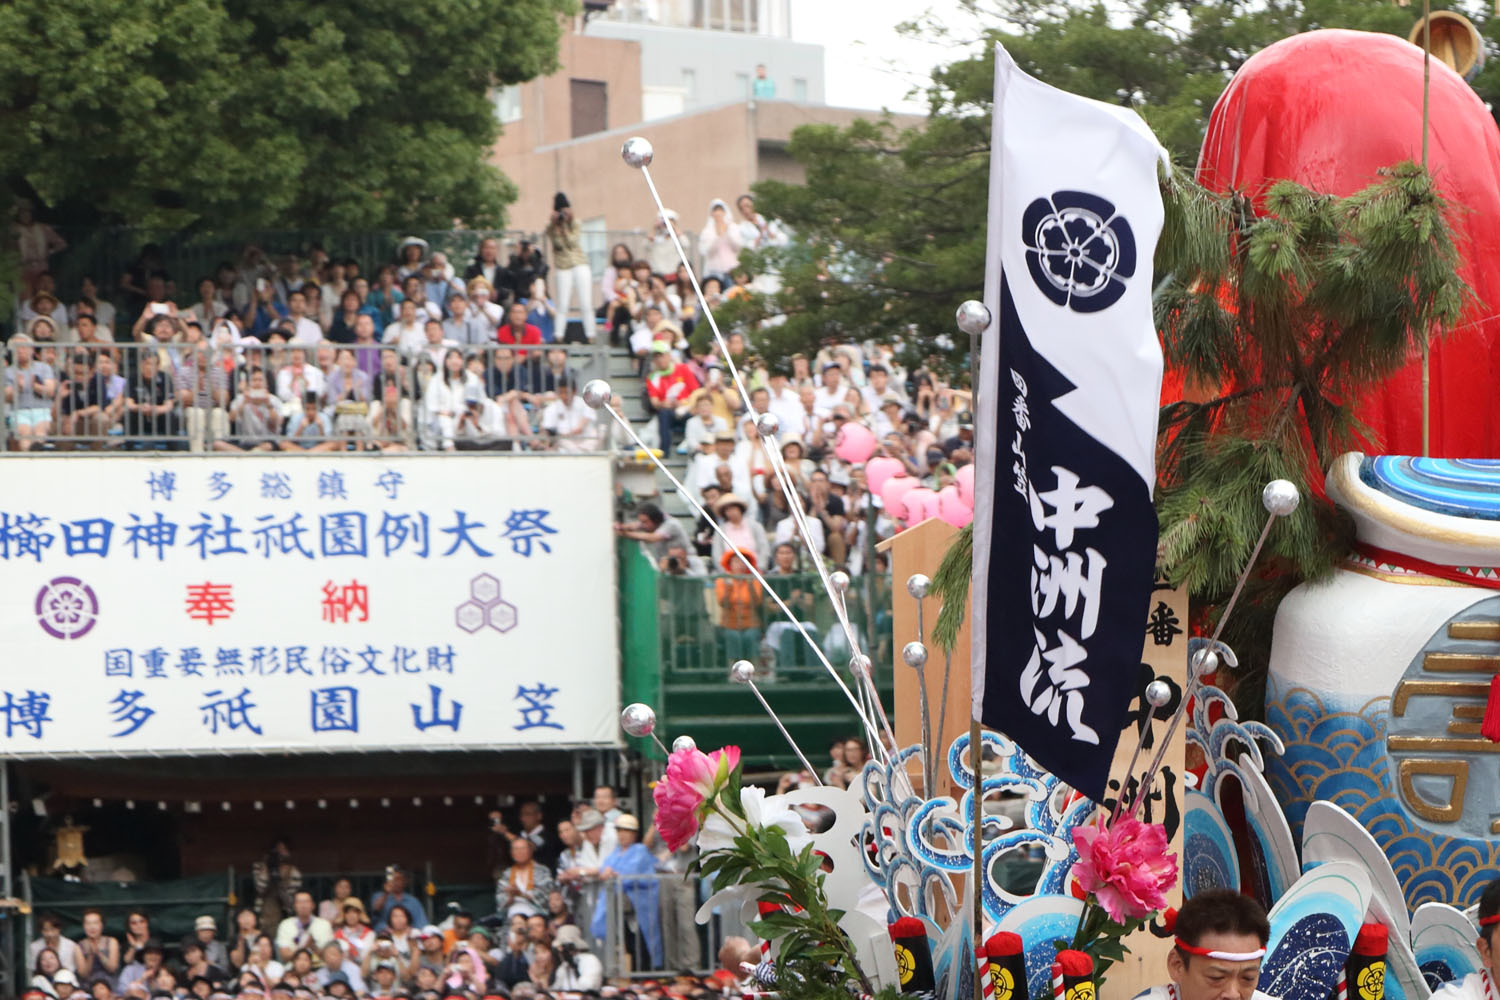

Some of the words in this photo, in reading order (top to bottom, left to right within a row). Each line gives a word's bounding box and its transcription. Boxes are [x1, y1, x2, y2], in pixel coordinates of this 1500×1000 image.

[0, 509, 559, 562] 櫛田神社祇園例大祭
[185, 579, 371, 626] 奉納
[1018, 465, 1114, 746] 中洲流
[104, 646, 457, 679] 国重要無形民俗文化財
[0, 683, 565, 738] 博多祇園山笠
